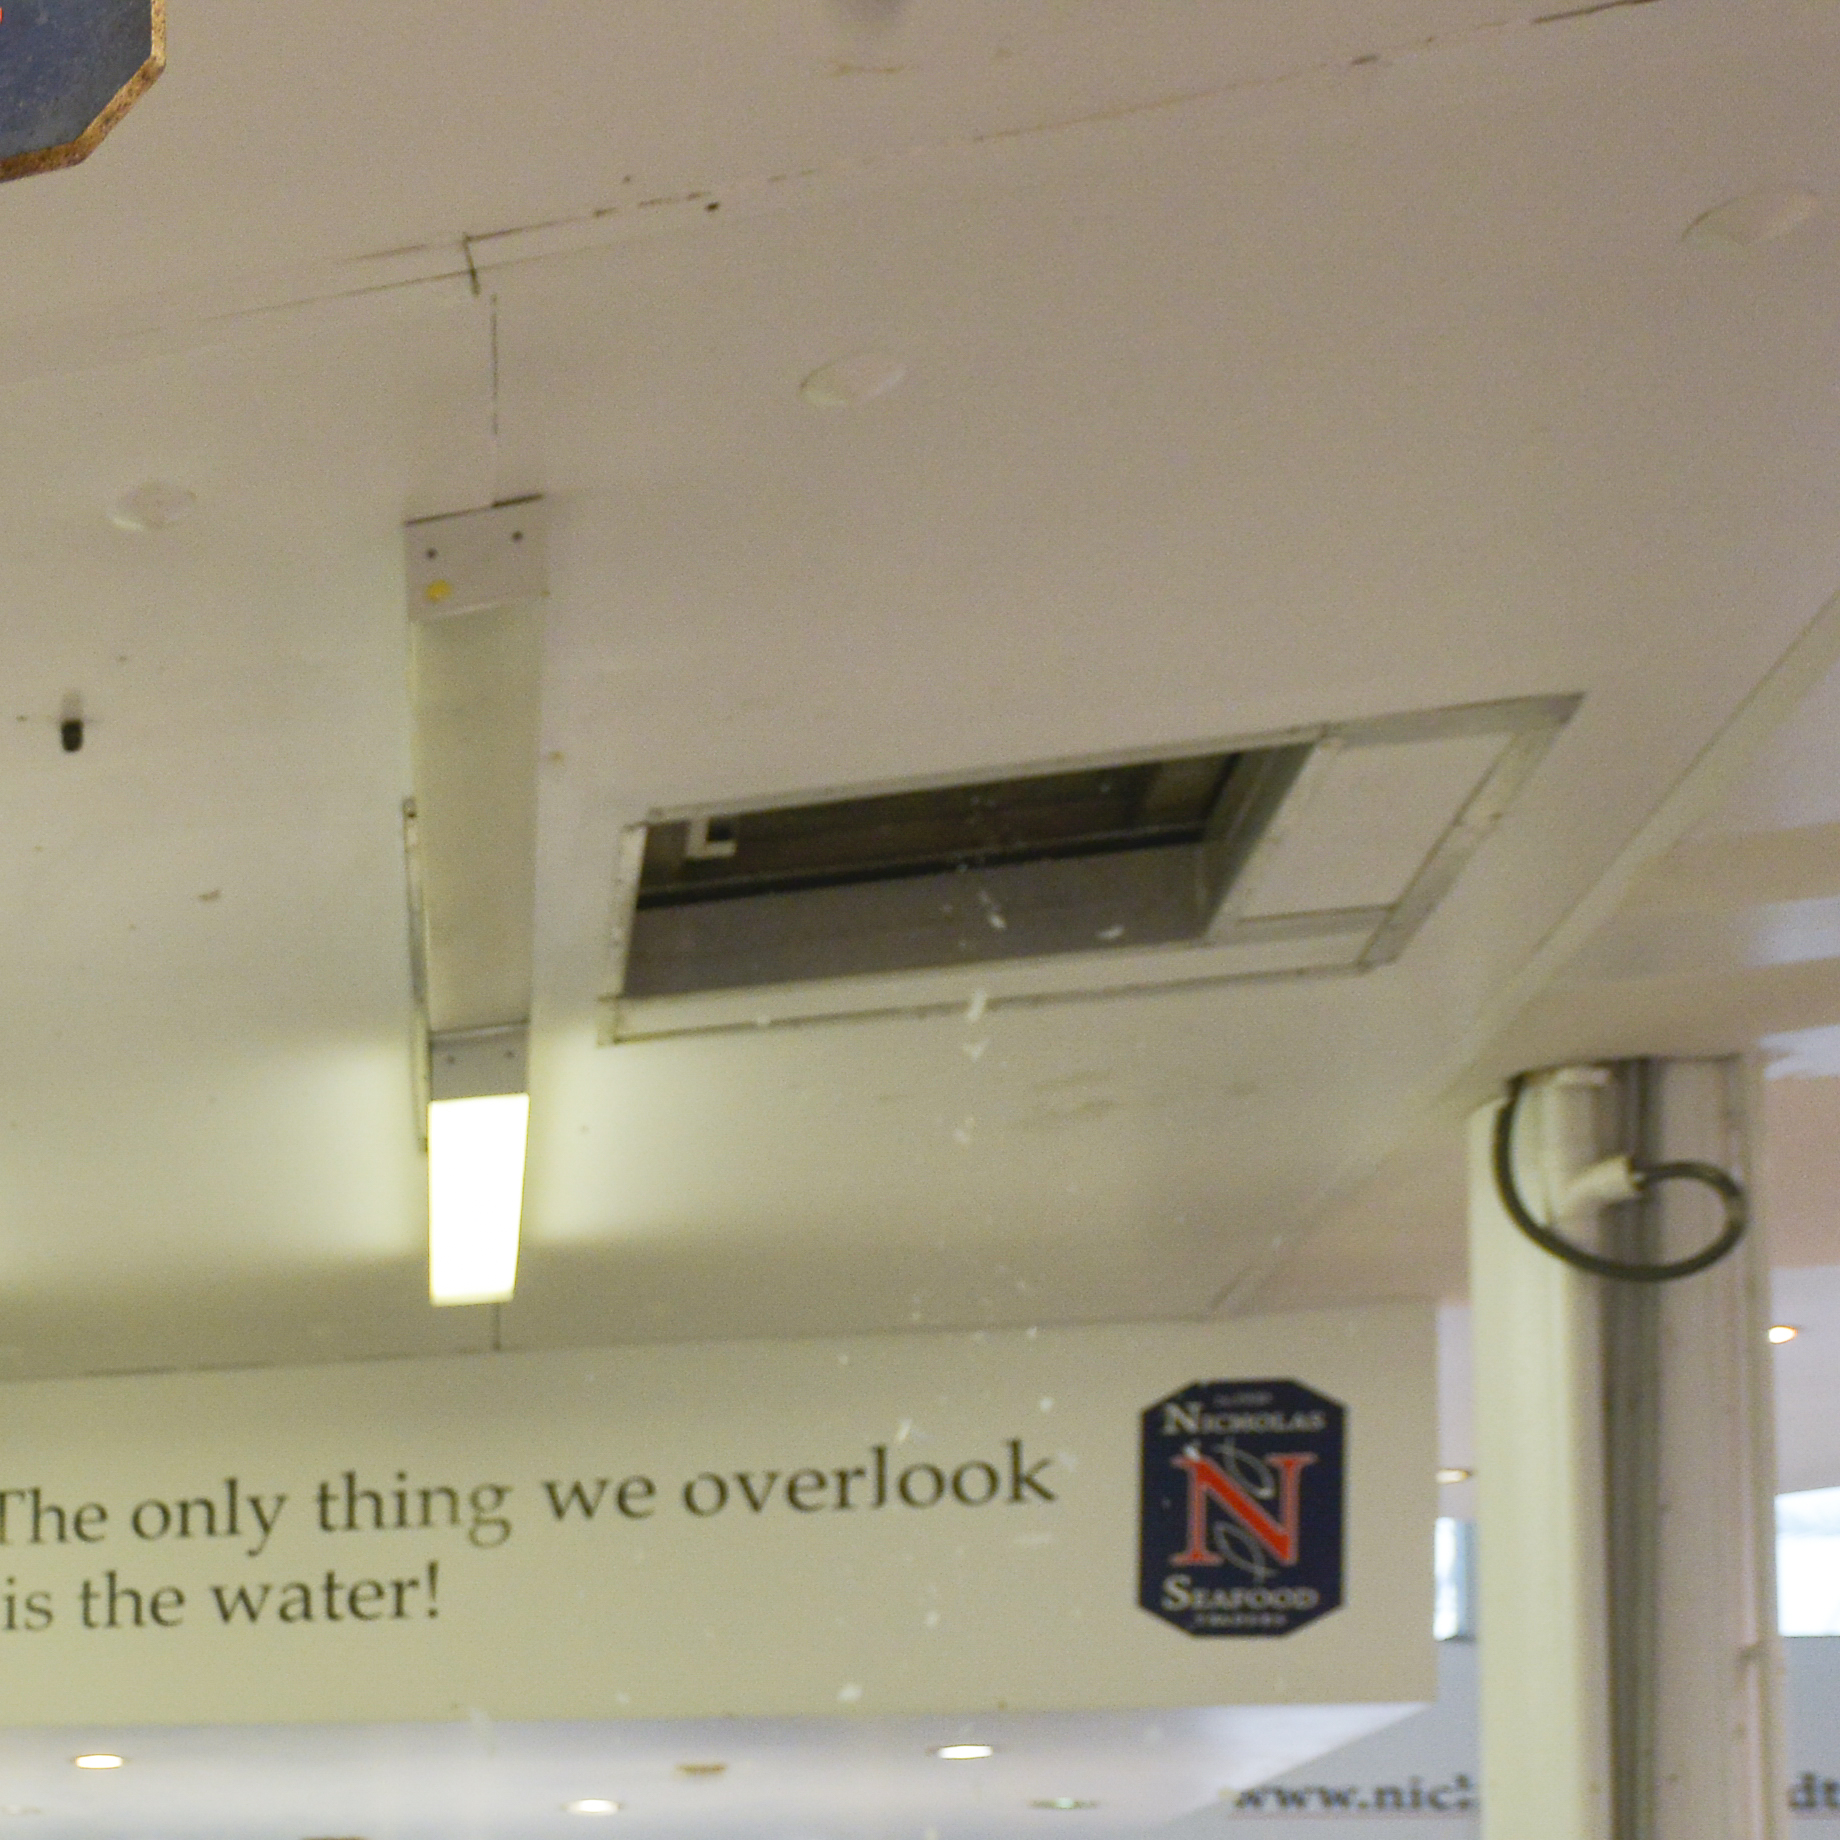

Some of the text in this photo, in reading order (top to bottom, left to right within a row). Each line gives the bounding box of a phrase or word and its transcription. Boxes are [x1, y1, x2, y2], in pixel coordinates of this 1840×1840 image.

[1162, 1401, 1326, 1436] NICHOLAS
[131, 1478, 286, 1556] only
[314, 1472, 513, 1549] thing
[543, 1467, 656, 1521] we
[681, 1439, 1056, 1519] overlook
[2, 1561, 441, 1630] is the water!
[1161, 1573, 1320, 1612] SEAFOOD
